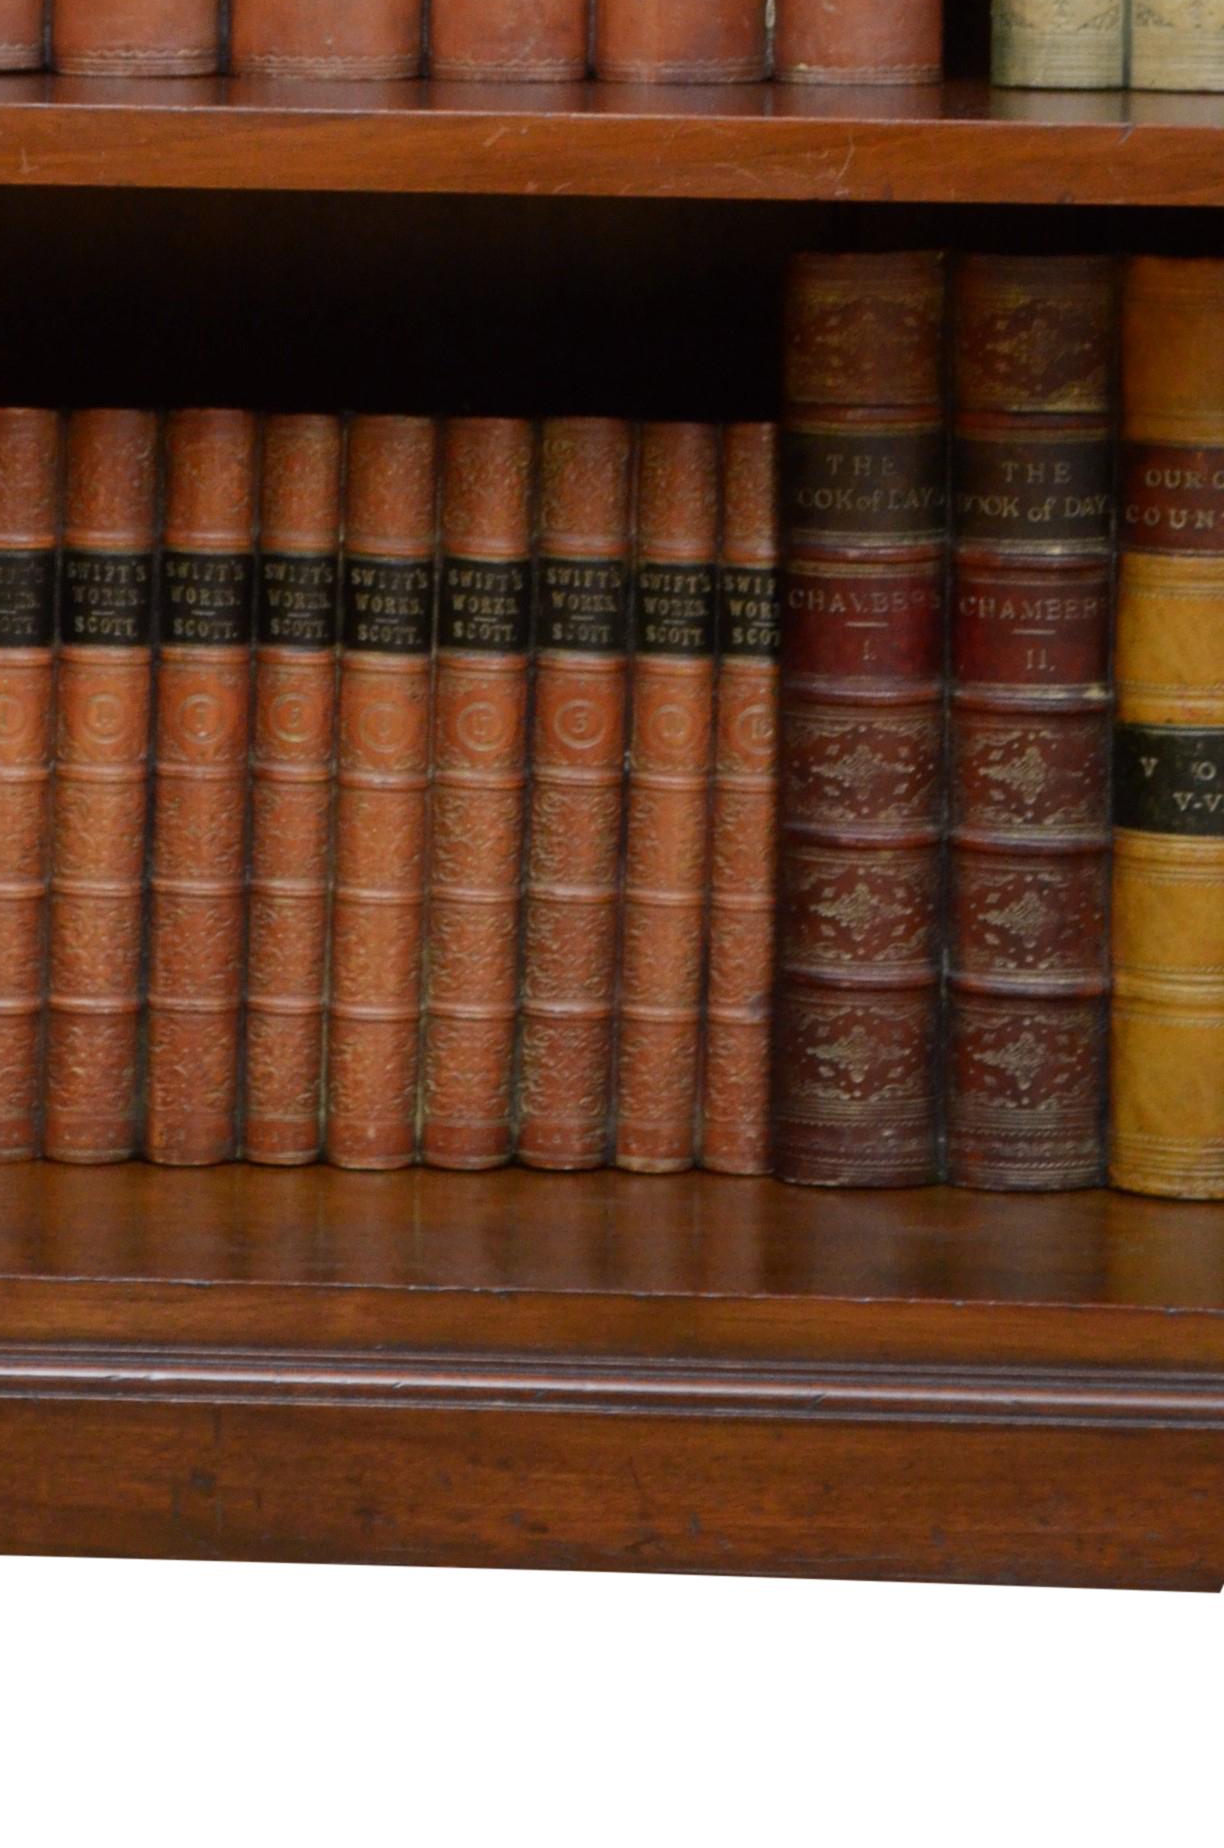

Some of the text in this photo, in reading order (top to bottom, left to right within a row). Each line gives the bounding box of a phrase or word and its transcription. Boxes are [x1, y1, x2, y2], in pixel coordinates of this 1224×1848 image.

[825, 452, 897, 478] THE
[1000, 459, 1073, 485] THE
[1144, 467, 1205, 490] OUR
[790, 487, 857, 510] OOK
[1026, 495, 1058, 523] of
[1124, 503, 1224, 531] COUN
[957, 595, 1104, 621] CHAMBER
[1024, 648, 1057, 672] II.
